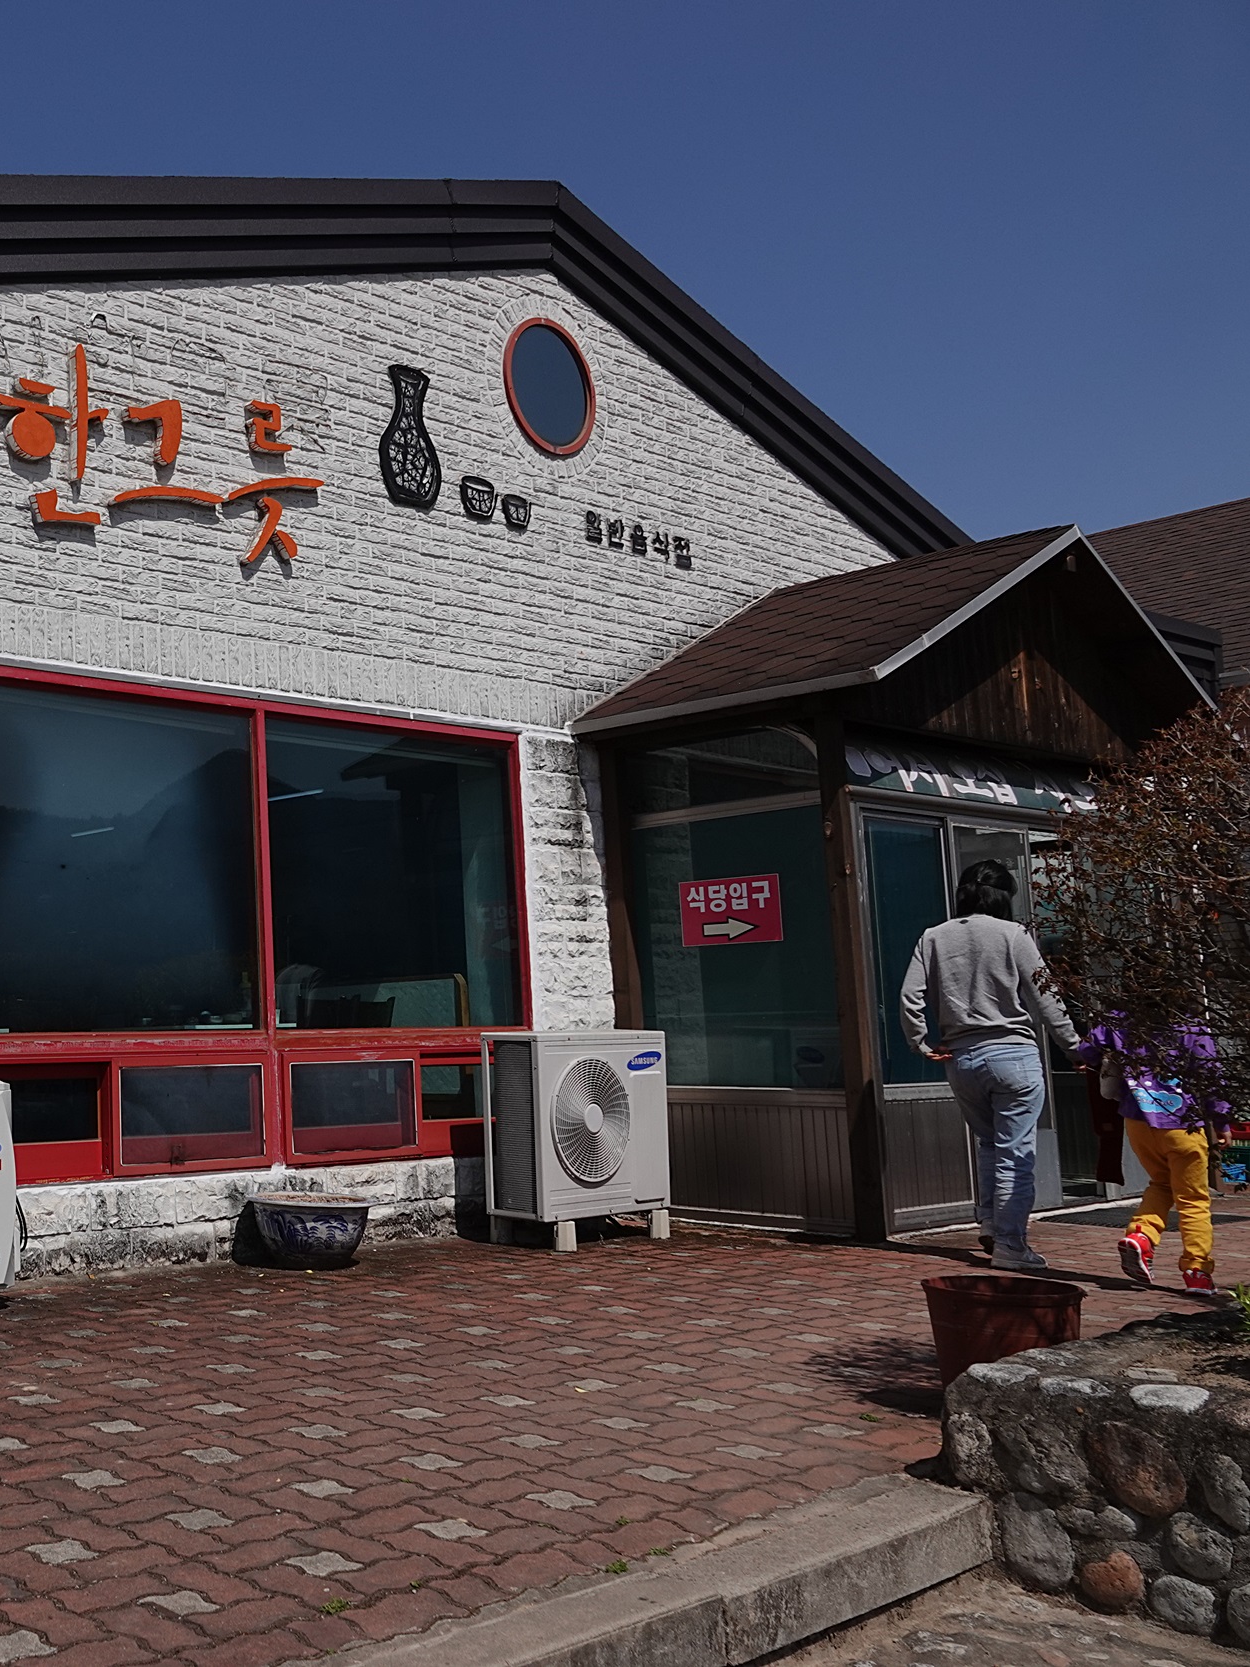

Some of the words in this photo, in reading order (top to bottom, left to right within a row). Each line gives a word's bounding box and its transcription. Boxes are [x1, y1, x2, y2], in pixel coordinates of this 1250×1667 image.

[585, 510, 692, 571] 일반음식점
[686, 880, 771, 913] 식당입구
[631, 1056, 658, 1065] SAMSUNG
